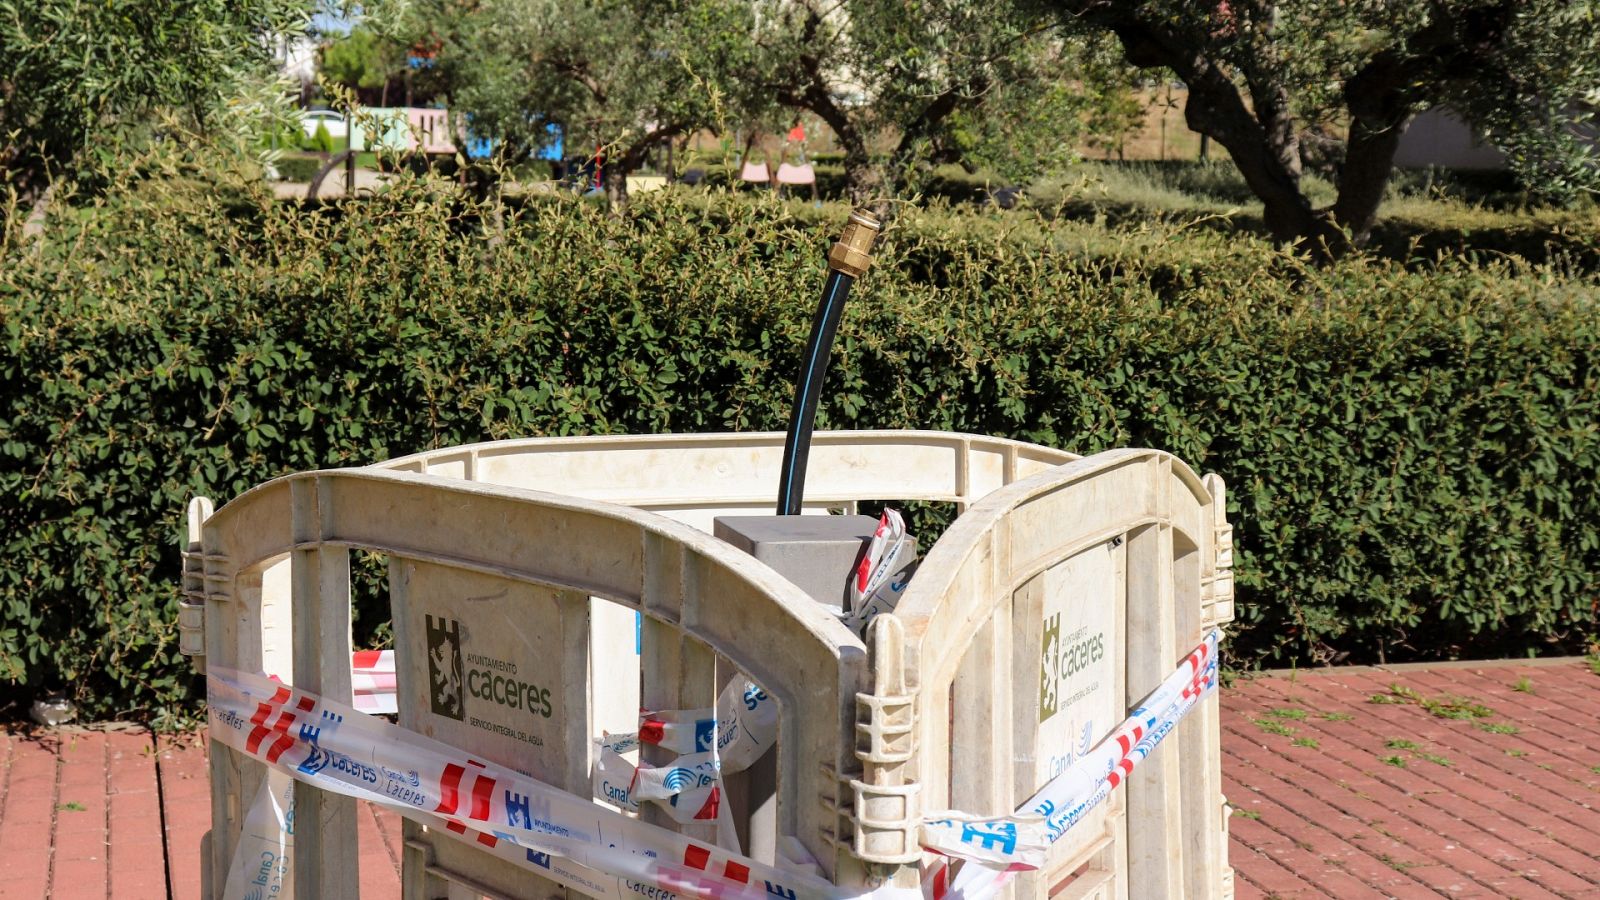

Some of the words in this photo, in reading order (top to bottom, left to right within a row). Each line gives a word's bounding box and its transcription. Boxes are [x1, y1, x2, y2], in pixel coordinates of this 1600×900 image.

[467, 653, 518, 675] AYUNTAMIENTO
[1061, 632, 1104, 680] cáceres
[468, 668, 552, 719] cáceres
[470, 716, 492, 732] SERVICIO
[493, 724, 518, 741] INTEGRAL
[517, 730, 528, 743] DEL
[528, 735, 544, 748] AGUA
[602, 780, 629, 804] Canal
